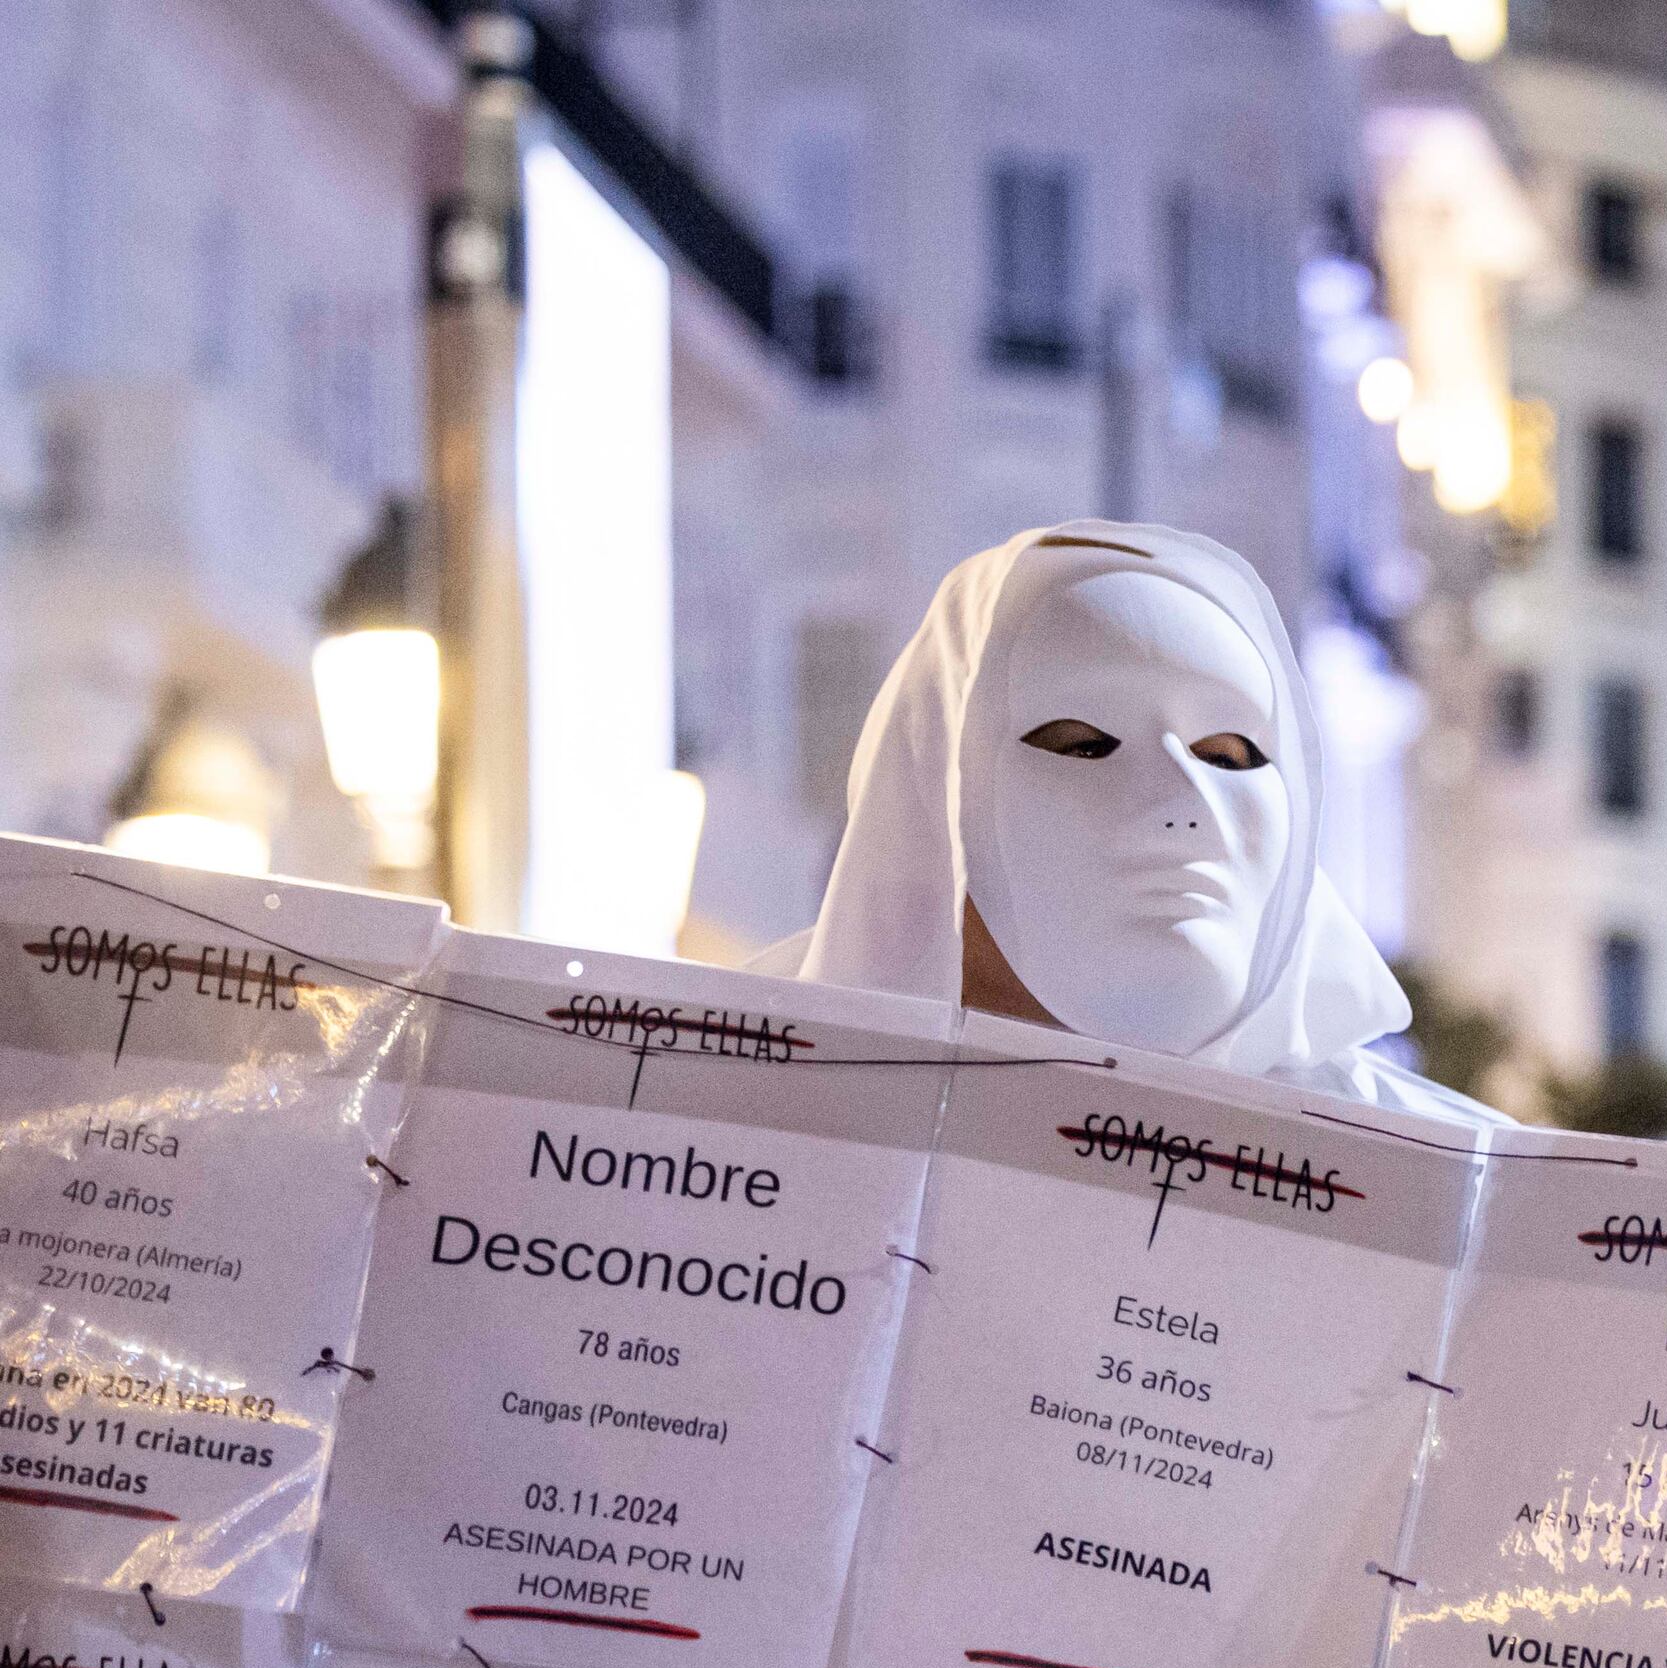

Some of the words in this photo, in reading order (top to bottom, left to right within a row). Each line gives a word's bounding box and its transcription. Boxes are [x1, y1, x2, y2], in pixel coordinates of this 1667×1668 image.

[562, 995, 679, 1050] SOMOS
[699, 1012, 798, 1065] ELLAS
[81, 1123, 182, 1159] Hafsa
[529, 1130, 781, 1209] Nombre
[61, 1178, 99, 1206] 40
[103, 1186, 174, 1219] años
[35, 1264, 172, 1304] 22/10/2024
[431, 1214, 847, 1317] Desconocido
[1112, 1294, 1220, 1346] Estela
[500, 1390, 583, 1424] Cangas
[588, 1403, 729, 1445] (Pontevedra)
[1029, 1393, 1114, 1431] Baiona
[1119, 1416, 1275, 1475] (Pontevedra)
[1075, 1441, 1213, 1490] 08/11/2024
[524, 1482, 679, 1527] 03.11.2024
[518, 1574, 647, 1609] HOMBRE
